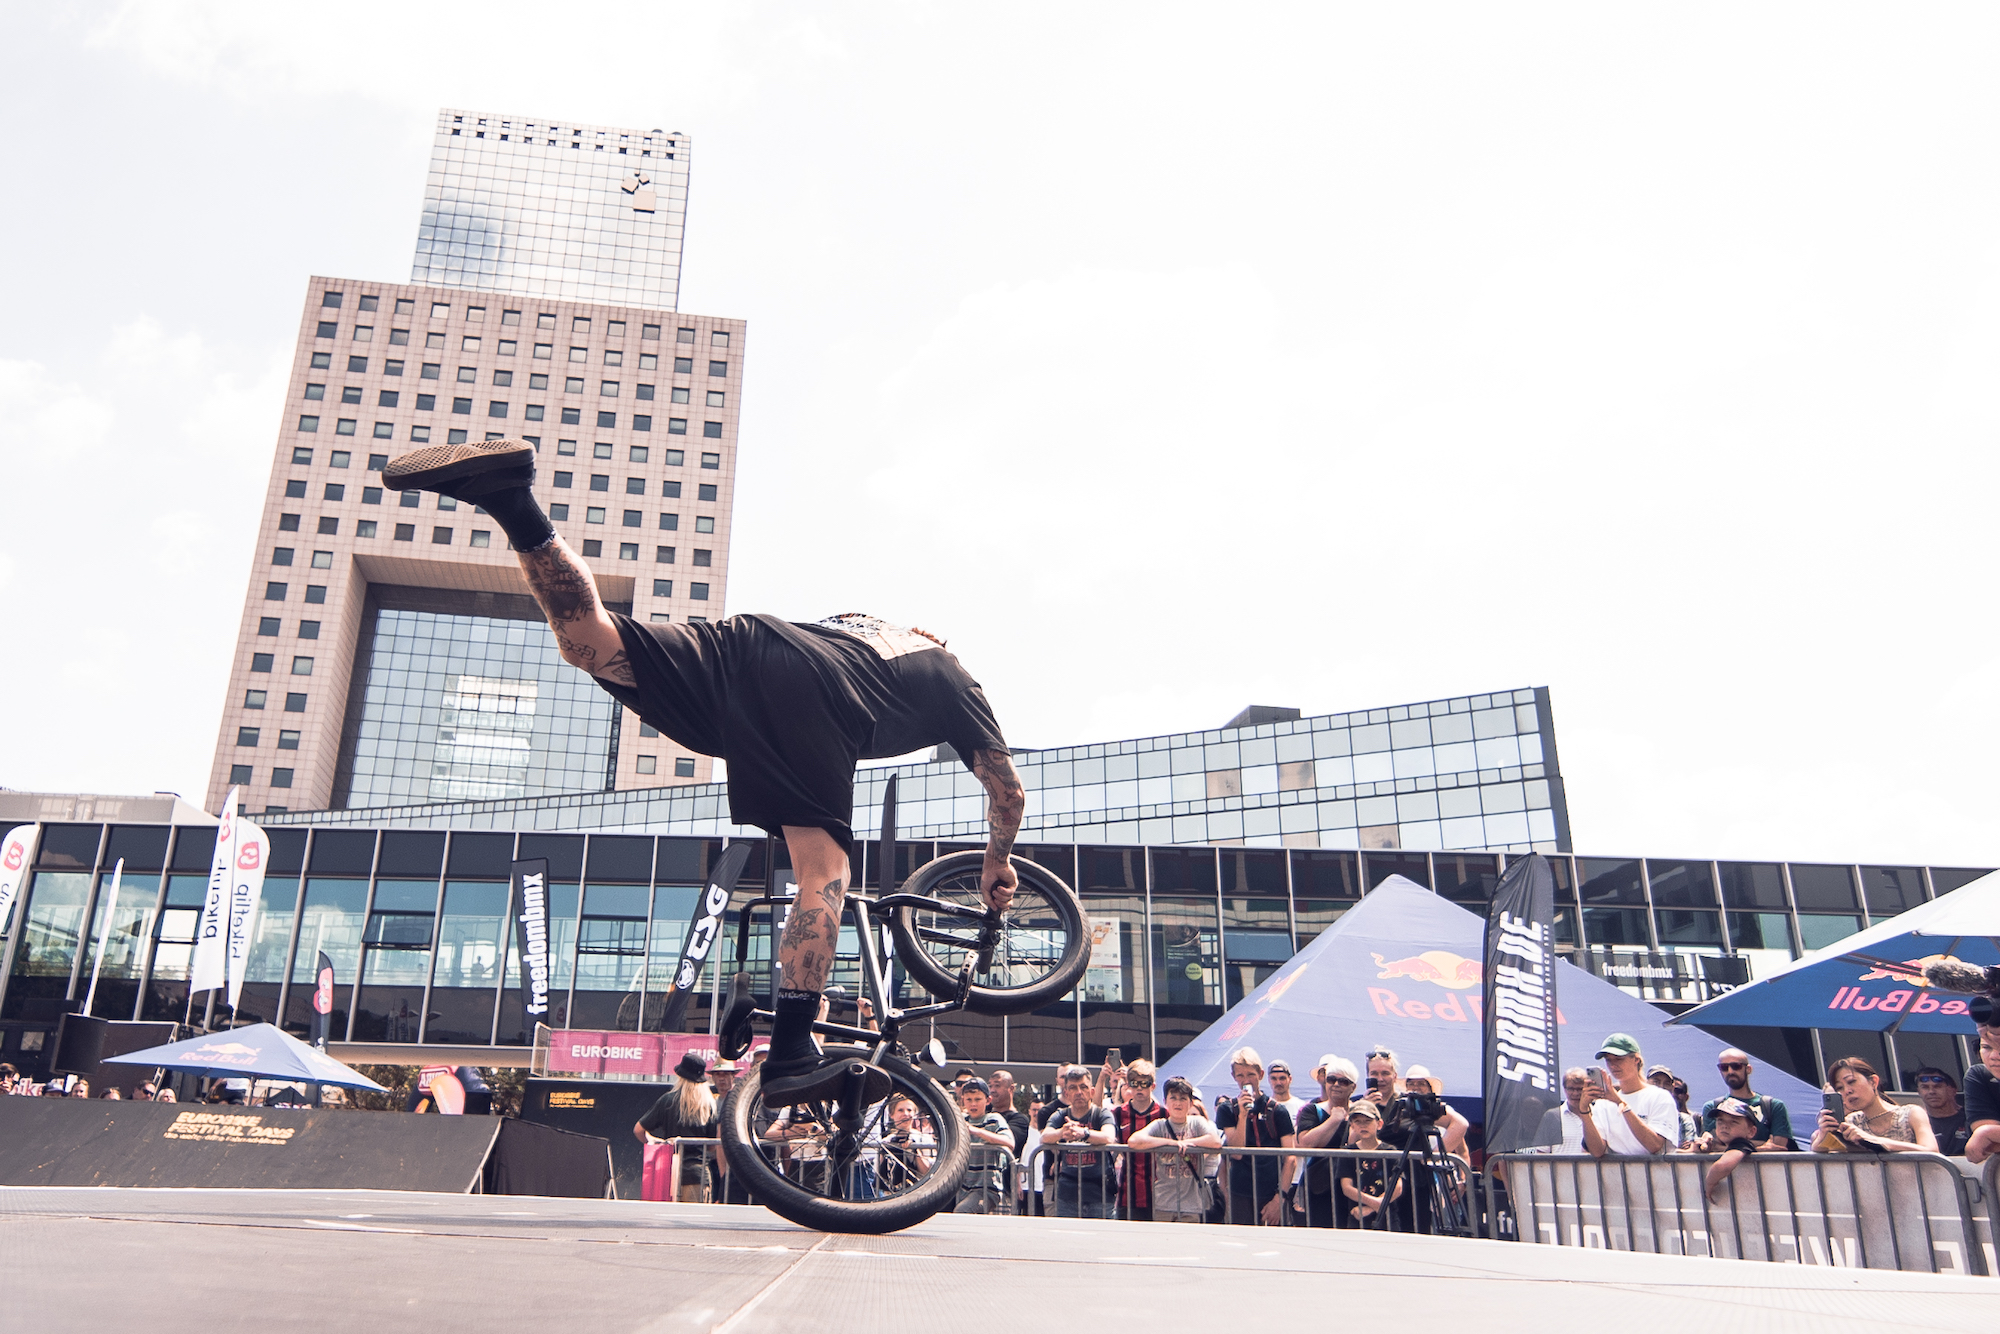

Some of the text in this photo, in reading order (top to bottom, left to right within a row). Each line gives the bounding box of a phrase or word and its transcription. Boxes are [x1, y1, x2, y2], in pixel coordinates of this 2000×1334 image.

[520, 872, 548, 1014] freedombmx
[1602, 962, 1673, 979] freedombmx
[1367, 986, 1468, 1023] Red
[572, 1044, 643, 1060] EUROBIKE
[175, 1111, 263, 1127] EUROBIKE
[167, 1122, 244, 1137] FESTIVAL
[247, 1125, 296, 1140] DAYS
